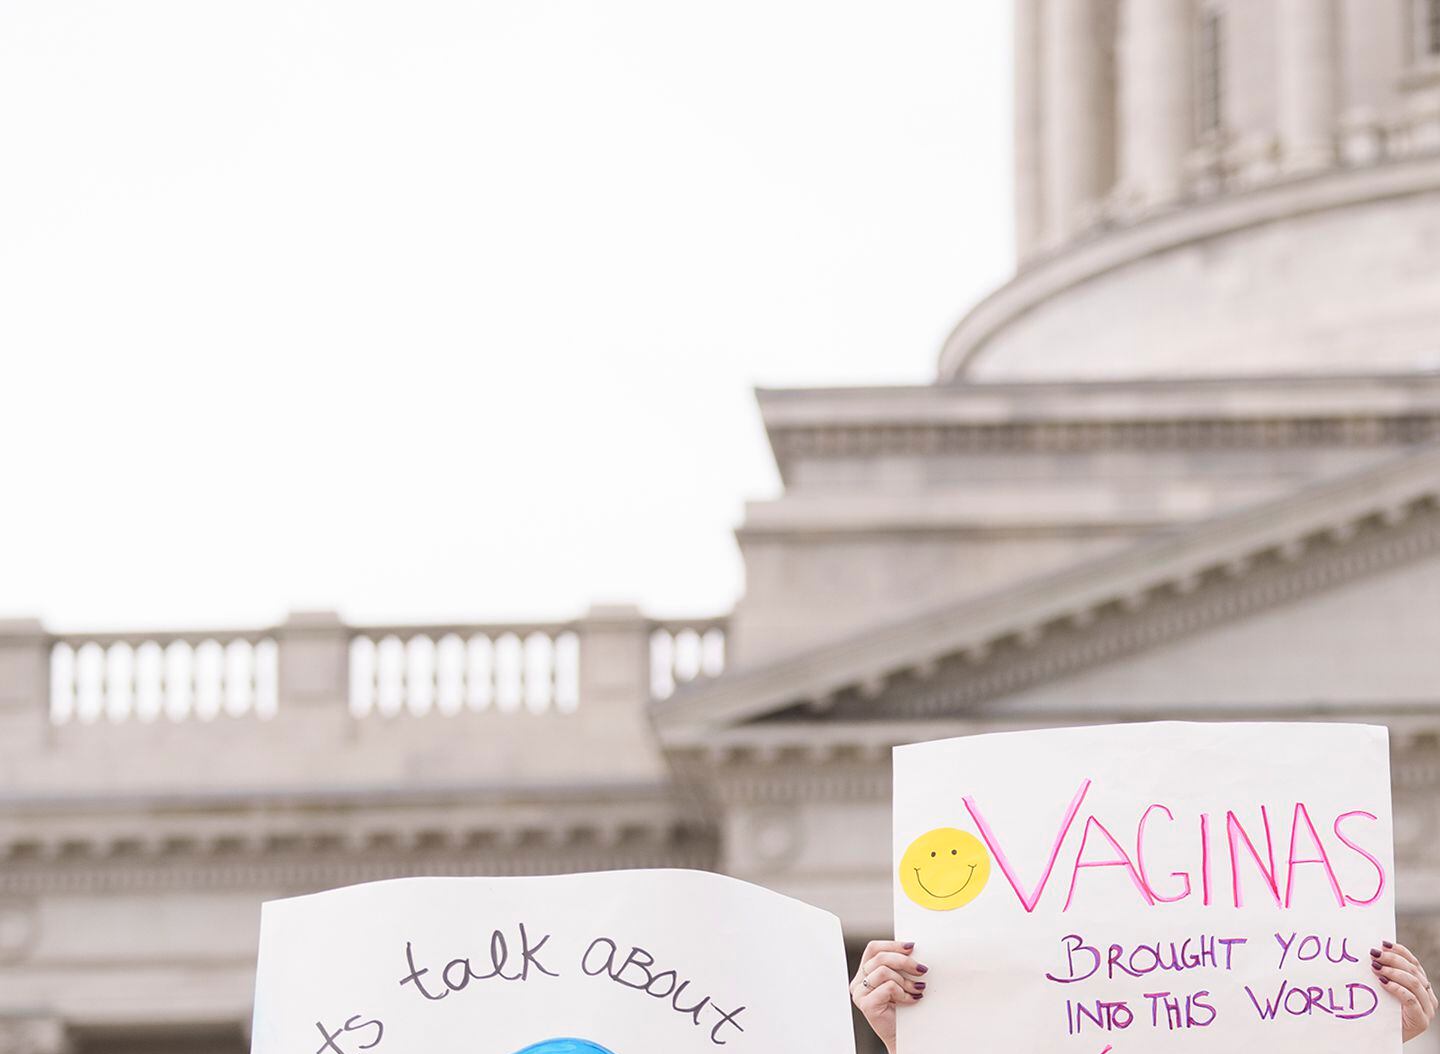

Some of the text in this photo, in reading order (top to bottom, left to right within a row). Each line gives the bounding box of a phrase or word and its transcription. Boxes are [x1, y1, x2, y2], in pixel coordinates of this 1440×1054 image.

[962, 778, 1386, 913] VAGINAS
[399, 922, 559, 1000] talk
[1045, 931, 1359, 983] BROUGHT YOU
[1067, 983, 1378, 1035] INTO THIS WORLD
